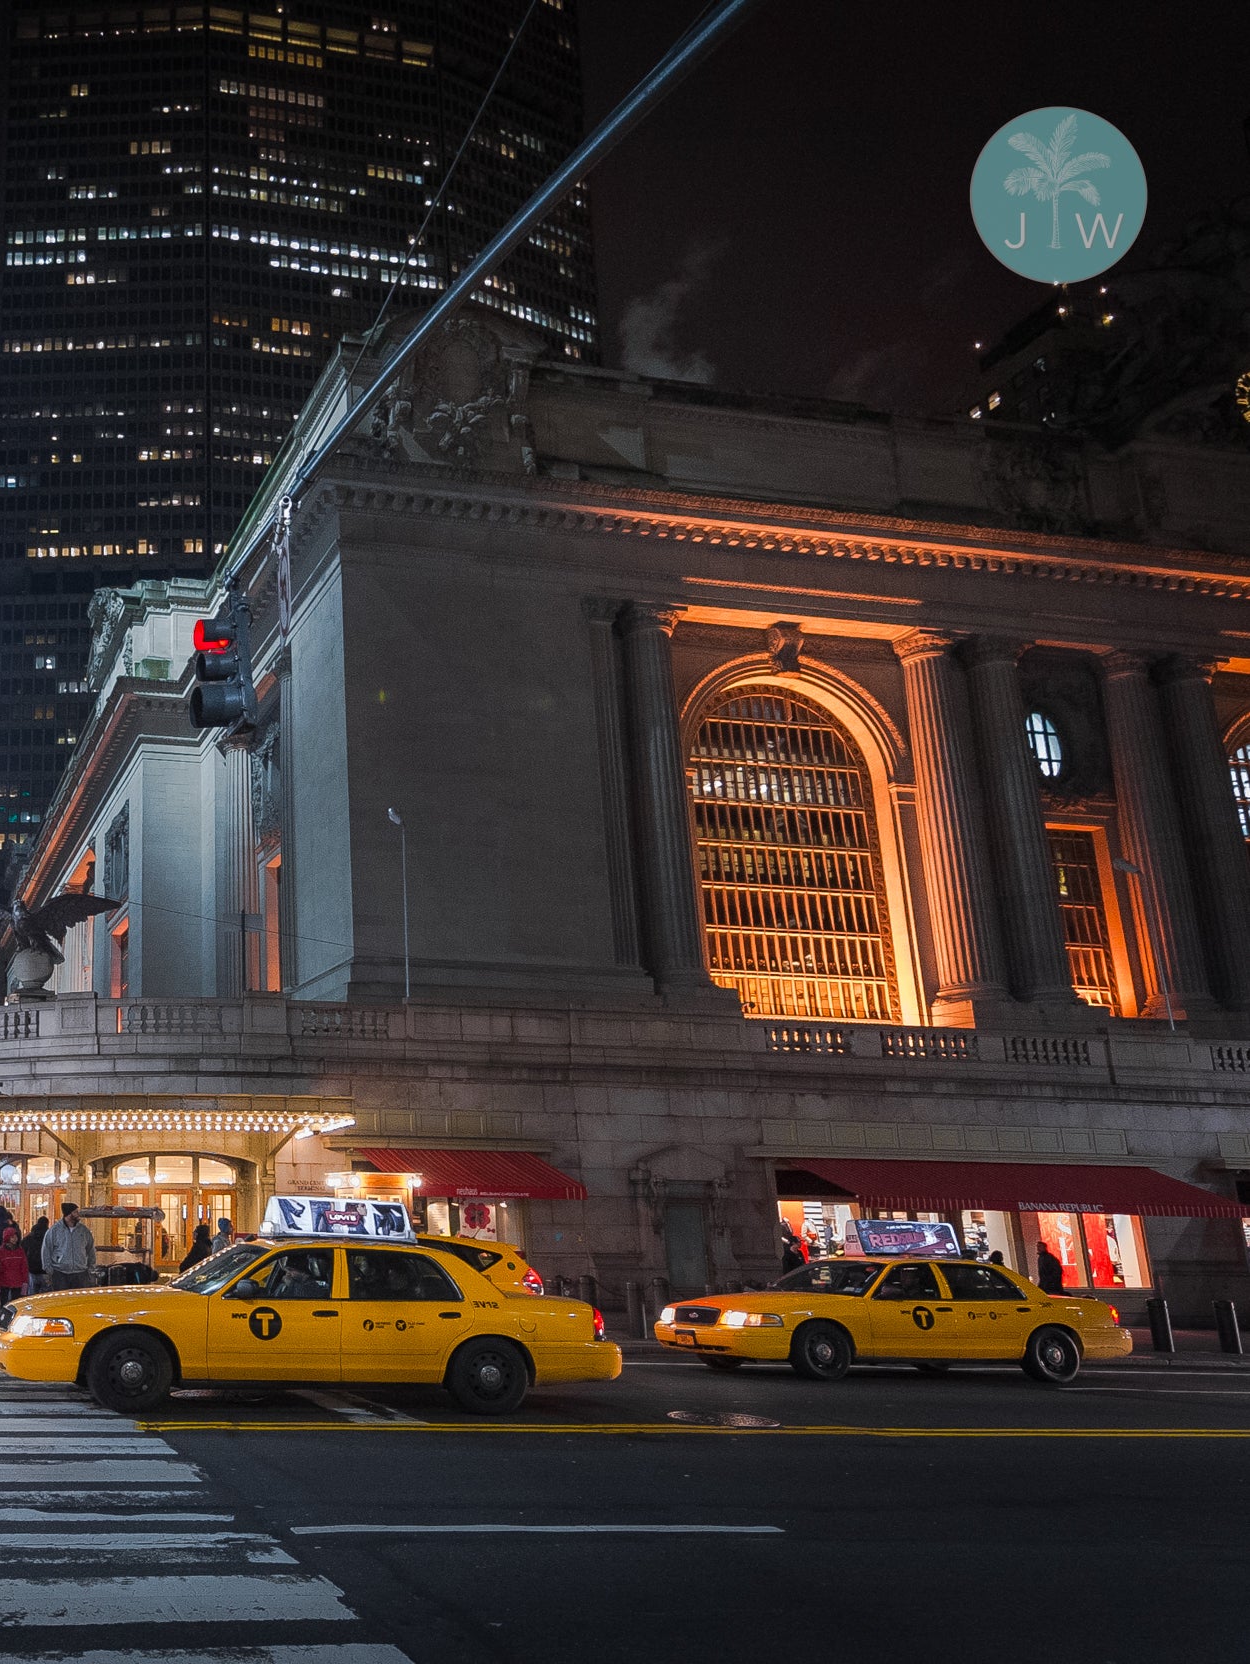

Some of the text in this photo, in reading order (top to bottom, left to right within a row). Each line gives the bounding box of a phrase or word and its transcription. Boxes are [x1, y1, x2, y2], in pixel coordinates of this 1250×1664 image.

[1018, 1201, 1105, 1213] BANANA REPUBLIC
[255, 1313, 275, 1337] T
[916, 1310, 928, 1328] T
